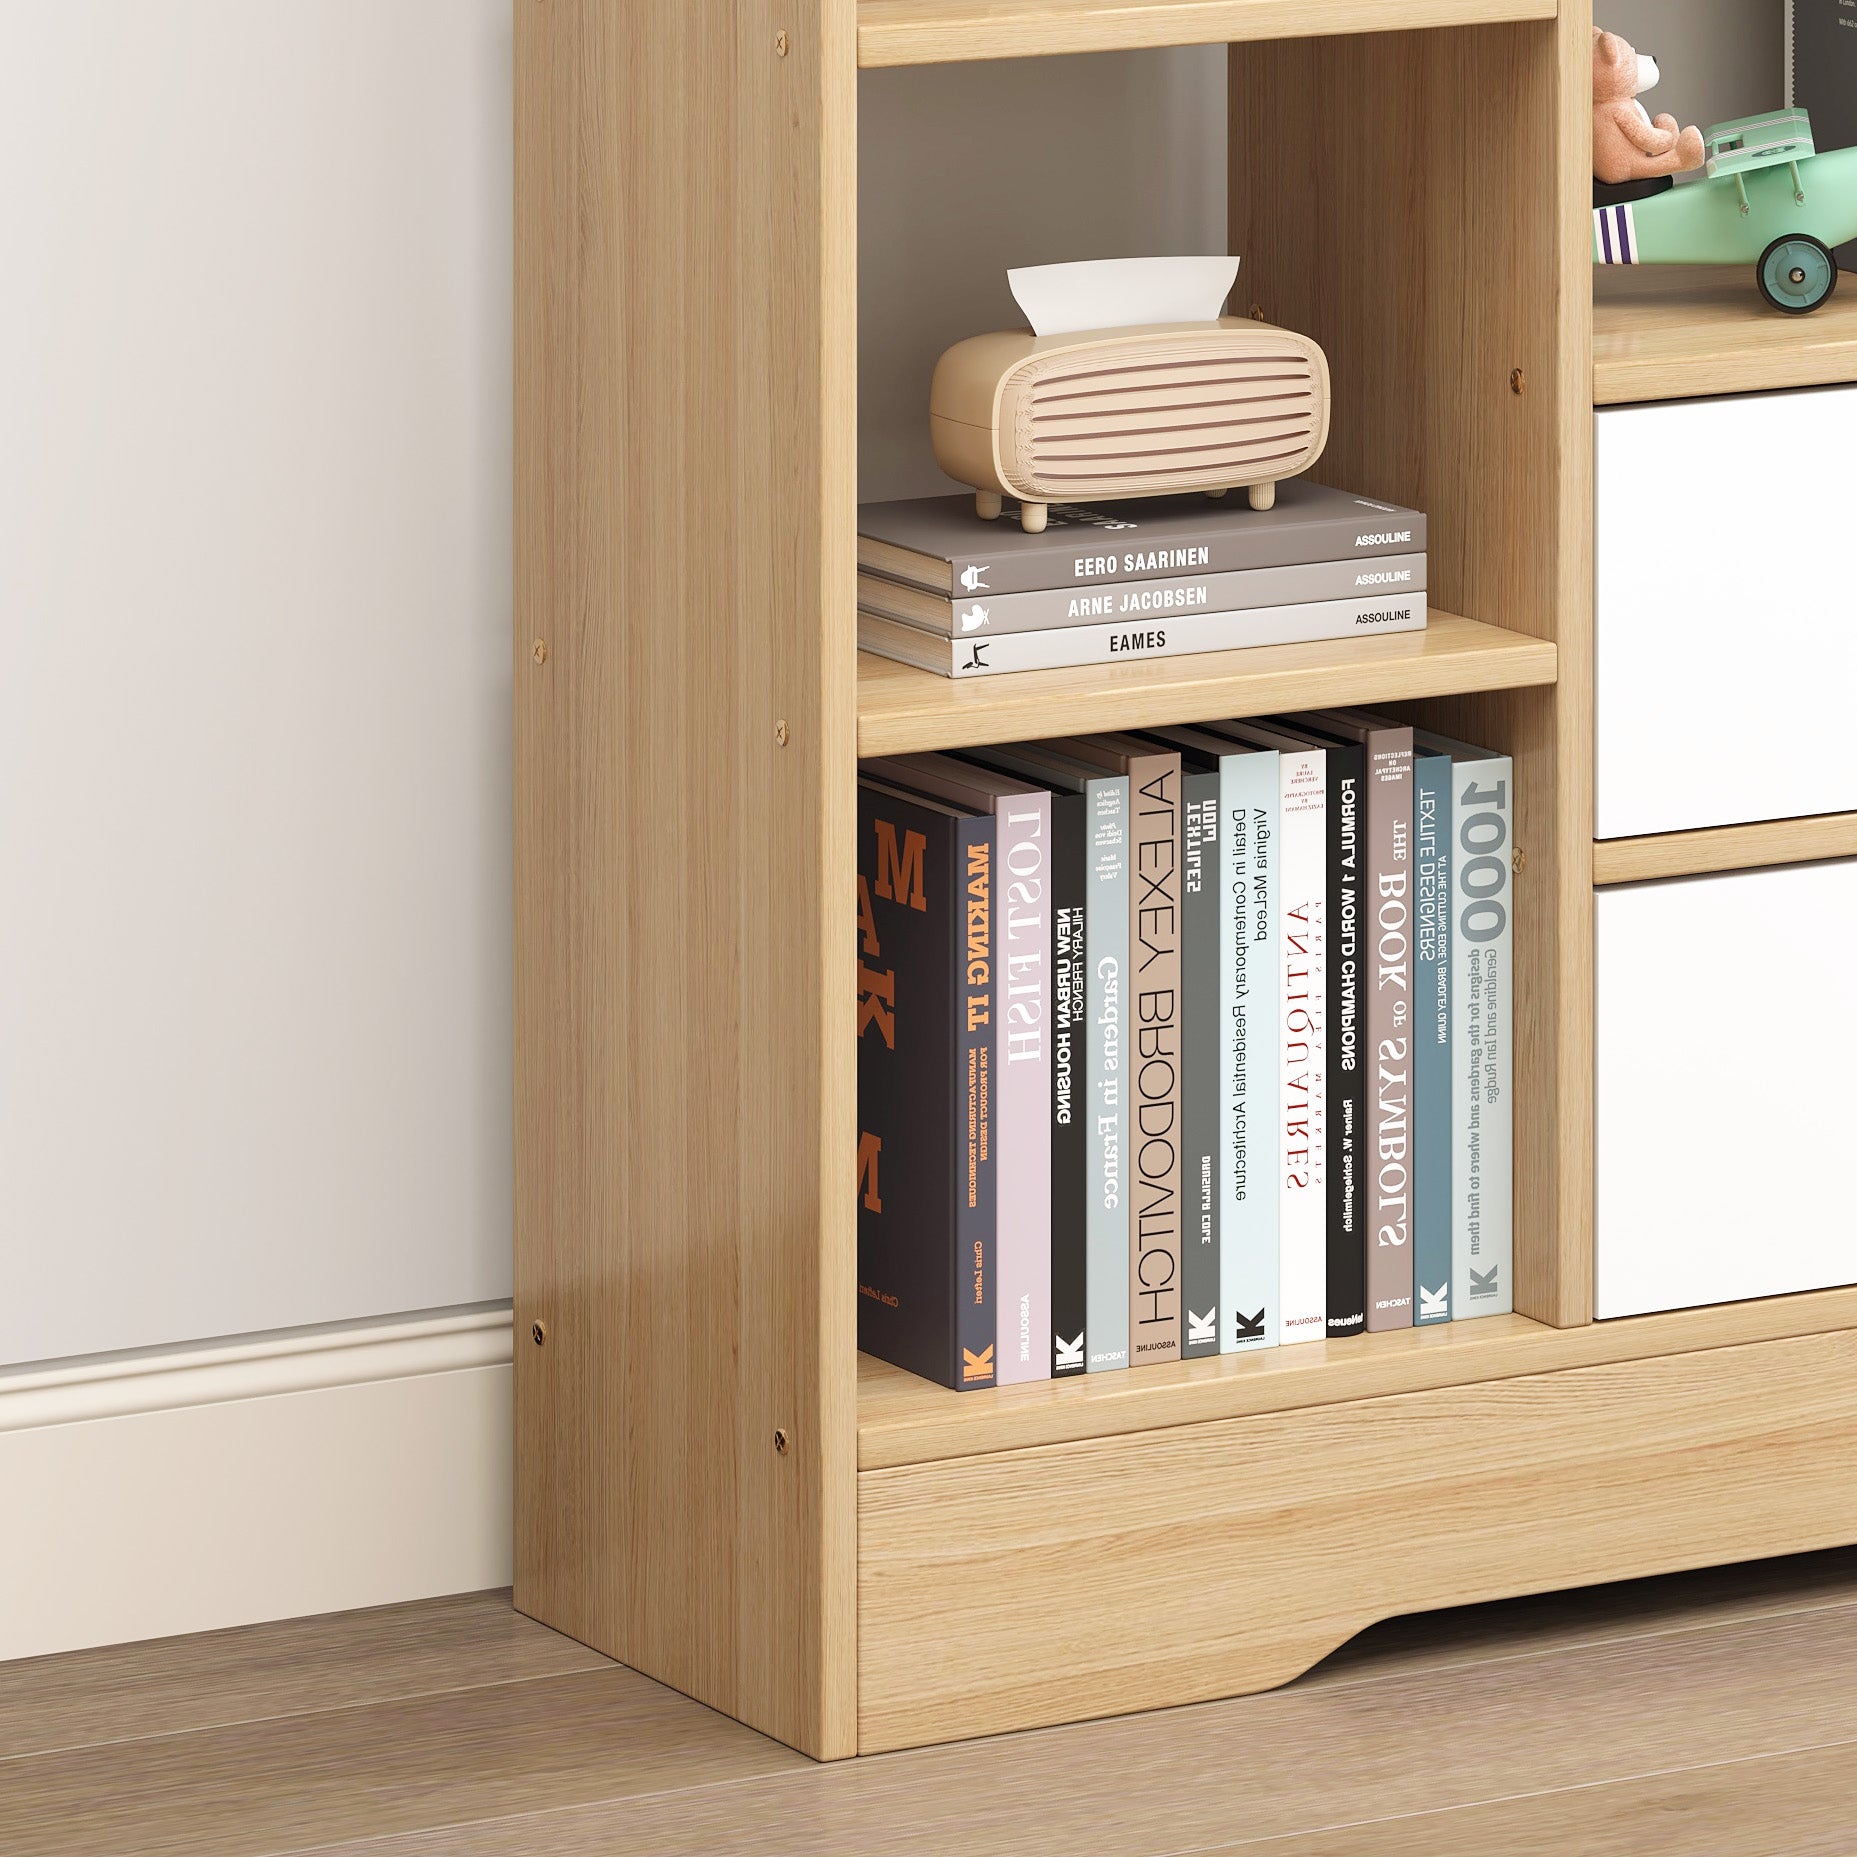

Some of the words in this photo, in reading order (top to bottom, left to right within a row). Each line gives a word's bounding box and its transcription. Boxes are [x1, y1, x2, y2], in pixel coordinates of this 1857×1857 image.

[1354, 531, 1411, 546] ASSOULINE
[1074, 556, 1118, 576] EERO
[1124, 547, 1208, 572] SAARINEN
[1354, 570, 1411, 585] ASSOULINE
[1068, 595, 1112, 617] ARNE
[1120, 587, 1207, 612] JACOBSEN
[1355, 610, 1411, 624] ASSOULINE
[1110, 631, 1166, 652] EAMES
